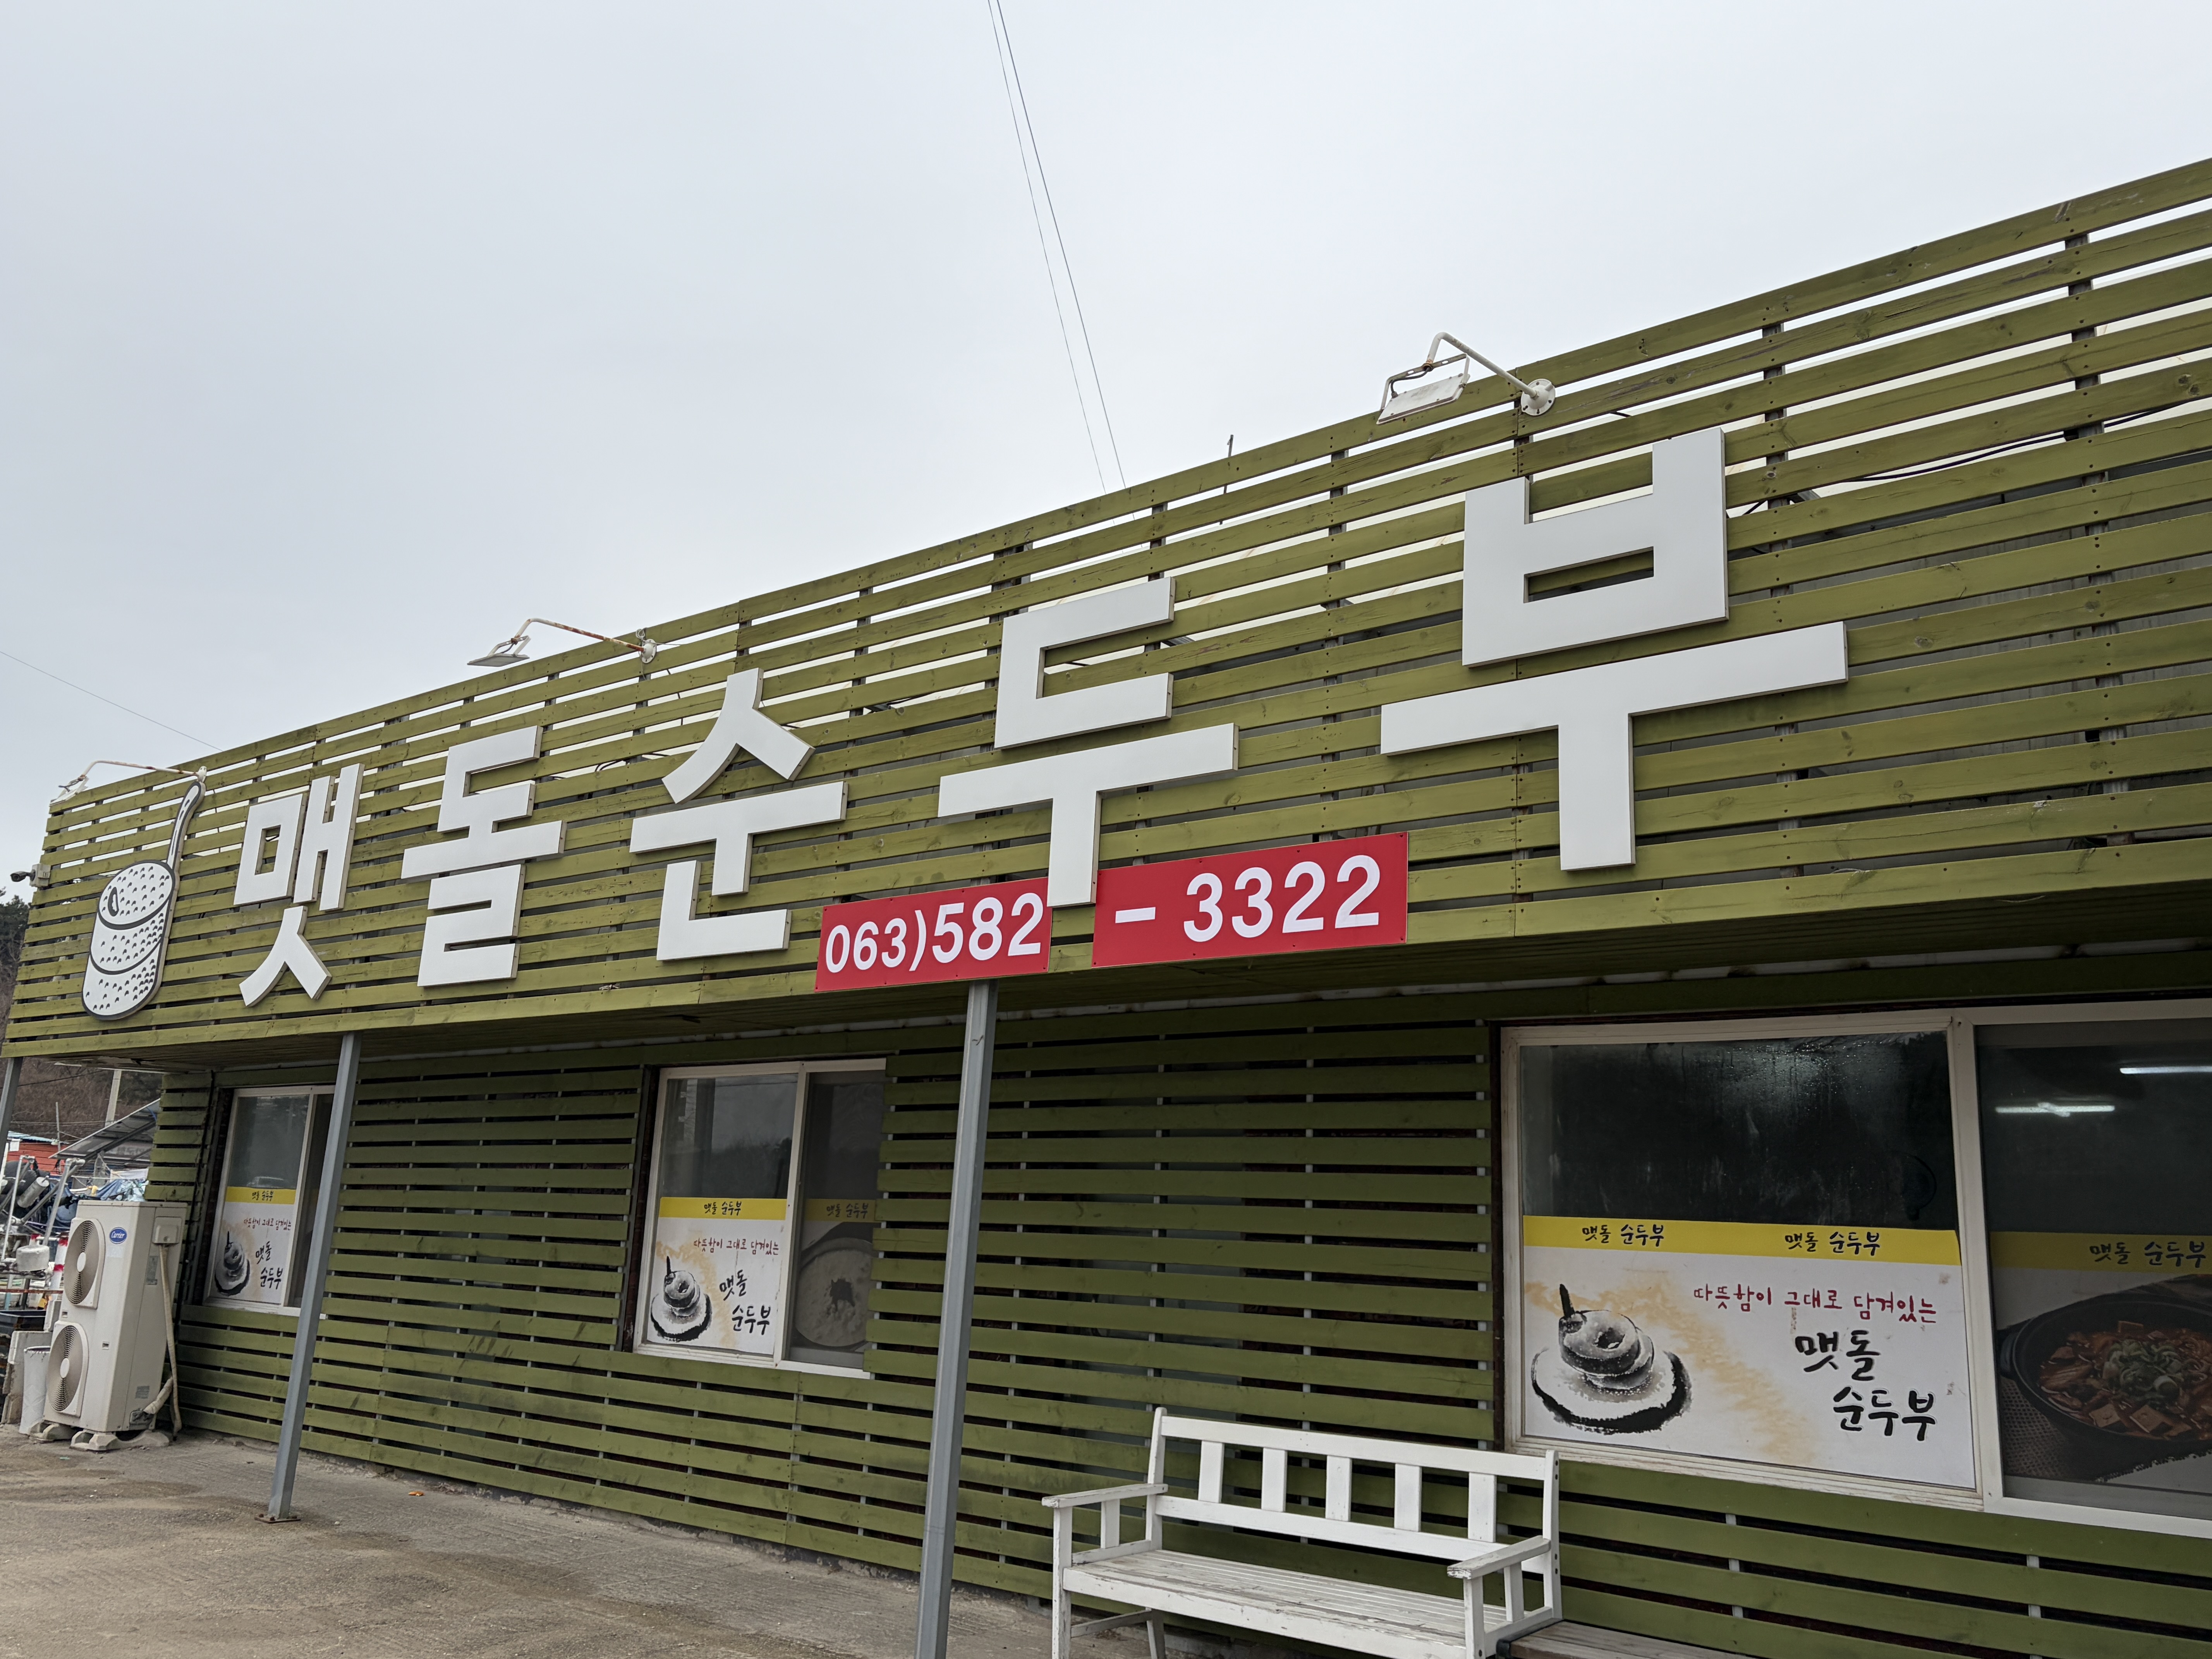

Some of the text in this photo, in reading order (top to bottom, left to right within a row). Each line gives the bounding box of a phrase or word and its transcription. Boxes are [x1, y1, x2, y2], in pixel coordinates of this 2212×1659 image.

[235, 426, 1849, 1008] 맷돌순두부
[826, 893, 1043, 972] 063)582
[262, 1191, 273, 1201] 순두부
[704, 1201, 741, 1216] 맷돌 순두부
[826, 1203, 868, 1219] 맷돌 순두부
[262, 1218, 273, 1227] 그대로
[693, 1237, 779, 1255] 따뜻함이 그대로 담겨있는
[1582, 1224, 1664, 1247] 맷돌 순두부
[1785, 1232, 1880, 1256] 맷돌 순두부
[256, 1241, 271, 1264] 맷돌
[2090, 1241, 2206, 1268] 맷돌 순두부
[260, 1267, 283, 1289] 순두부
[720, 1270, 747, 1301] 맷돌
[1694, 1283, 1936, 1323] 따뜻함이 그대로 담겨있는
[732, 1305, 771, 1335] 순두부
[1795, 1330, 1880, 1381] 맷돌
[1833, 1387, 1935, 1441] 순두부
